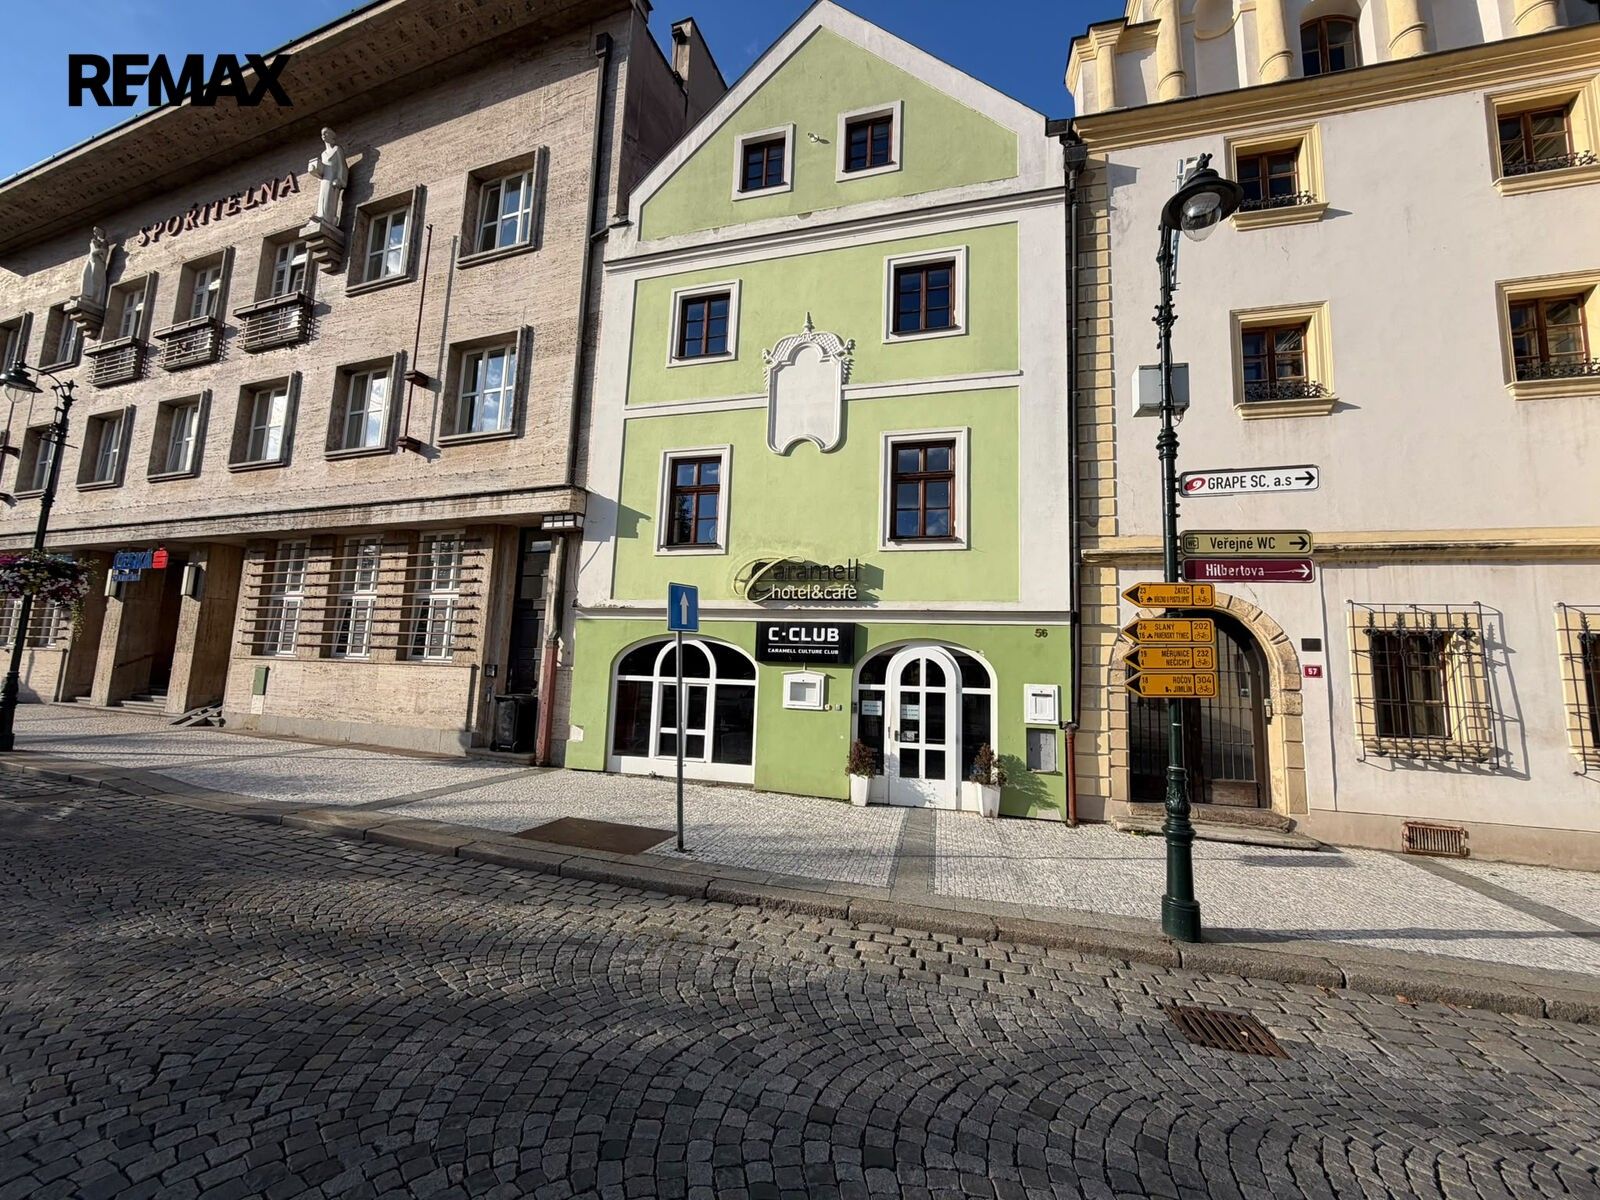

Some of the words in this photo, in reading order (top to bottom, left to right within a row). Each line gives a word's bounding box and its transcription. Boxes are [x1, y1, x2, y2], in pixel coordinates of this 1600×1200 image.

[137, 171, 300, 247] SPOŘITELNA
[1208, 476, 1247, 490] GRAPE
[1250, 475, 1270, 488] SC.
[1210, 537, 1253, 551] Veřejné
[1257, 537, 1276, 549] WC
[1205, 564, 1265, 577] Hilbertova
[1035, 629, 1048, 638] 56
